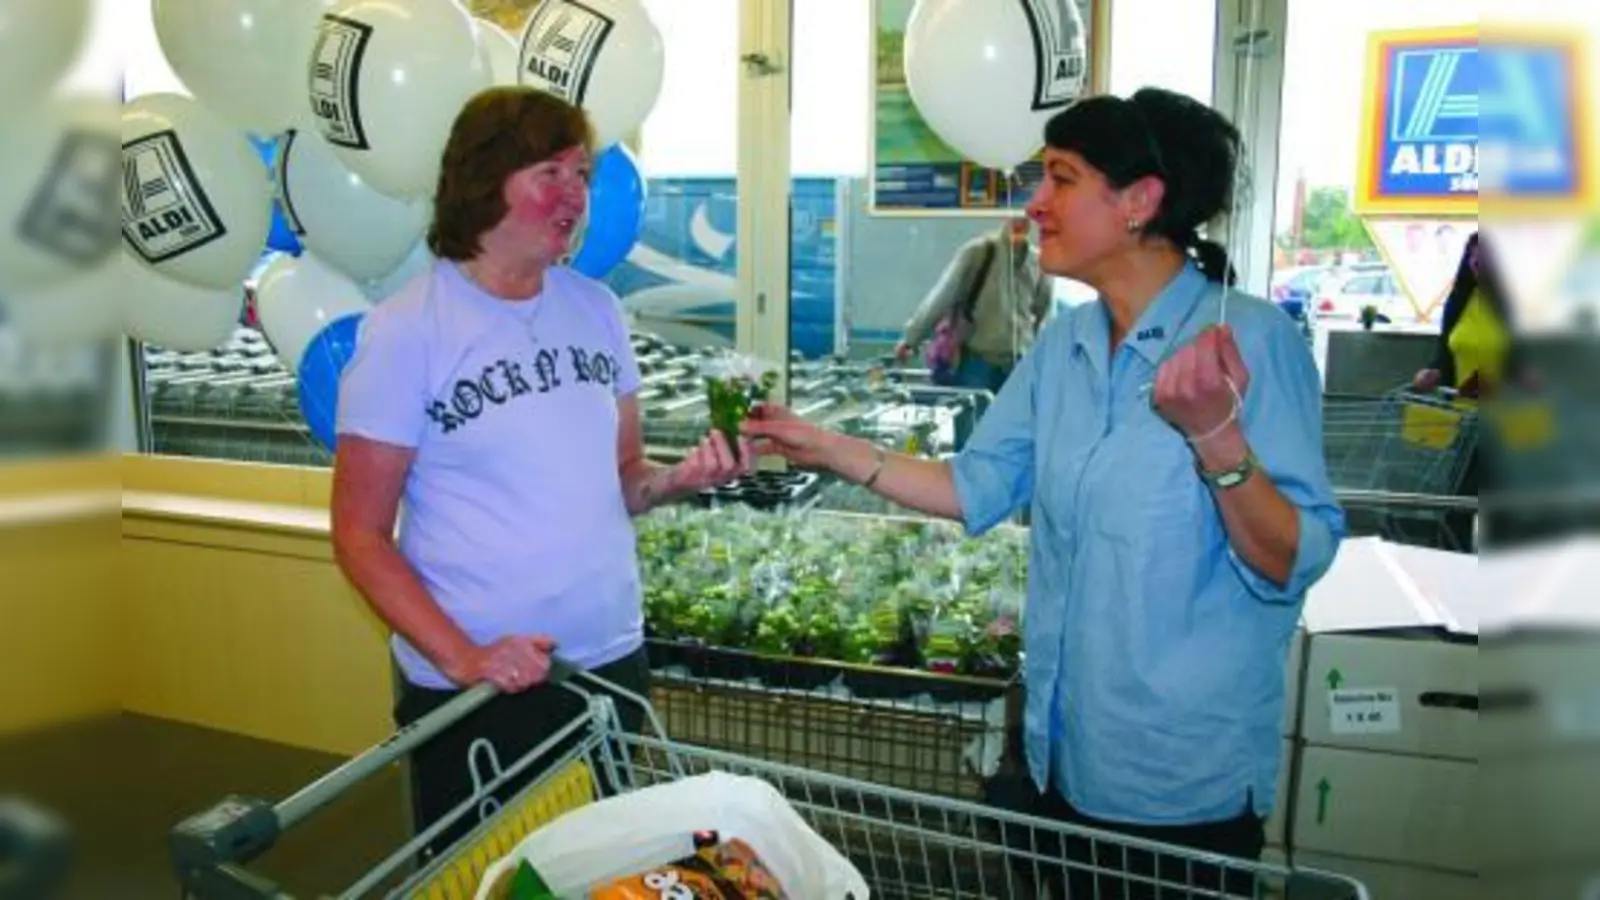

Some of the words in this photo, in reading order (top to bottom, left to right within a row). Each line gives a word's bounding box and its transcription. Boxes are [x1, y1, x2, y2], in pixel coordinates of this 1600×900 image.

[527, 57, 570, 87] ALDI
[1391, 144, 1478, 174] ALD
[138, 205, 194, 240] ALDI
[426, 358, 530, 434] ROCK
